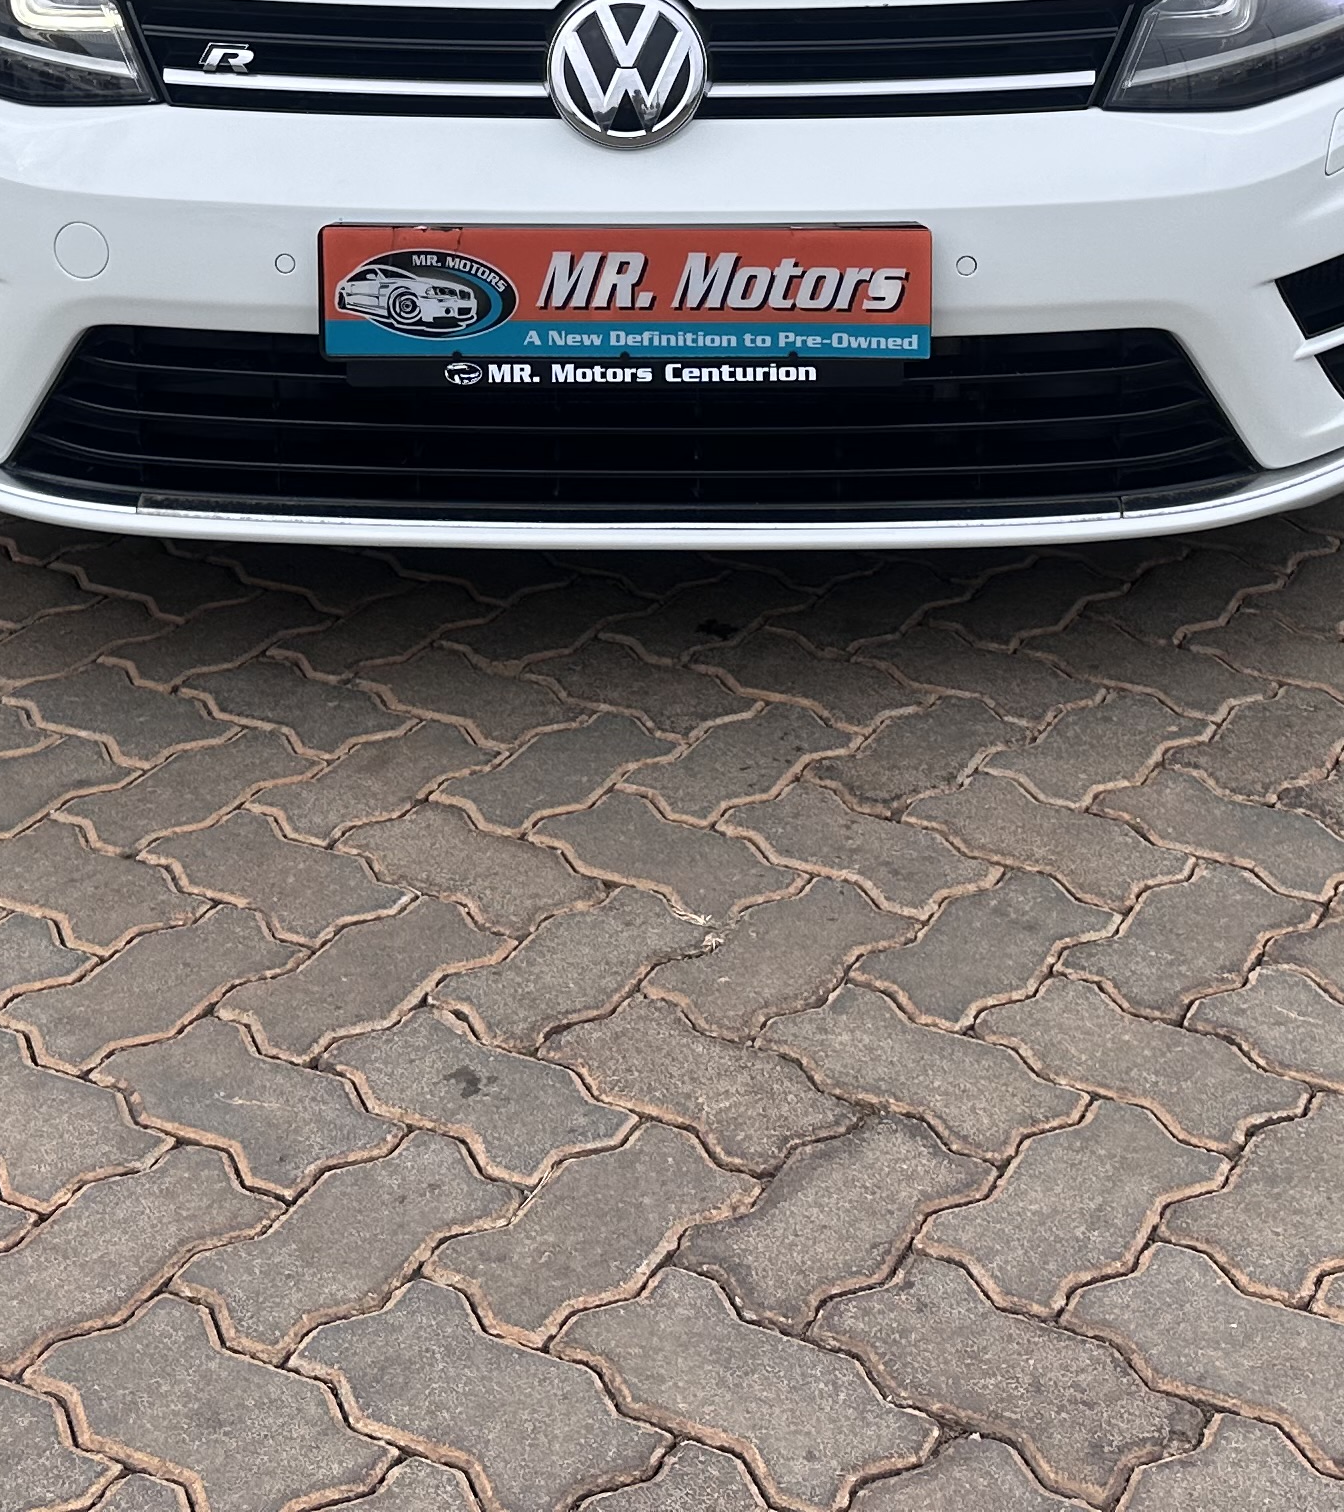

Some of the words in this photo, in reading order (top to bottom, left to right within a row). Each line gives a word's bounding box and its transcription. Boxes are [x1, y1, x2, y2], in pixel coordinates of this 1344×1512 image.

[199, 42, 255, 74] R
[411, 254, 442, 267] MR.
[445, 255, 508, 293] MOTORS
[535, 250, 657, 311] MR.
[670, 251, 910, 313] Motors
[523, 329, 542, 346] A
[548, 330, 603, 347] New
[609, 330, 738, 348] Definition
[743, 331, 771, 349] to
[778, 331, 919, 351] Pre-Owned
[487, 363, 541, 383] MR.
[551, 363, 653, 383] Motors
[664, 363, 817, 383] Centurion
